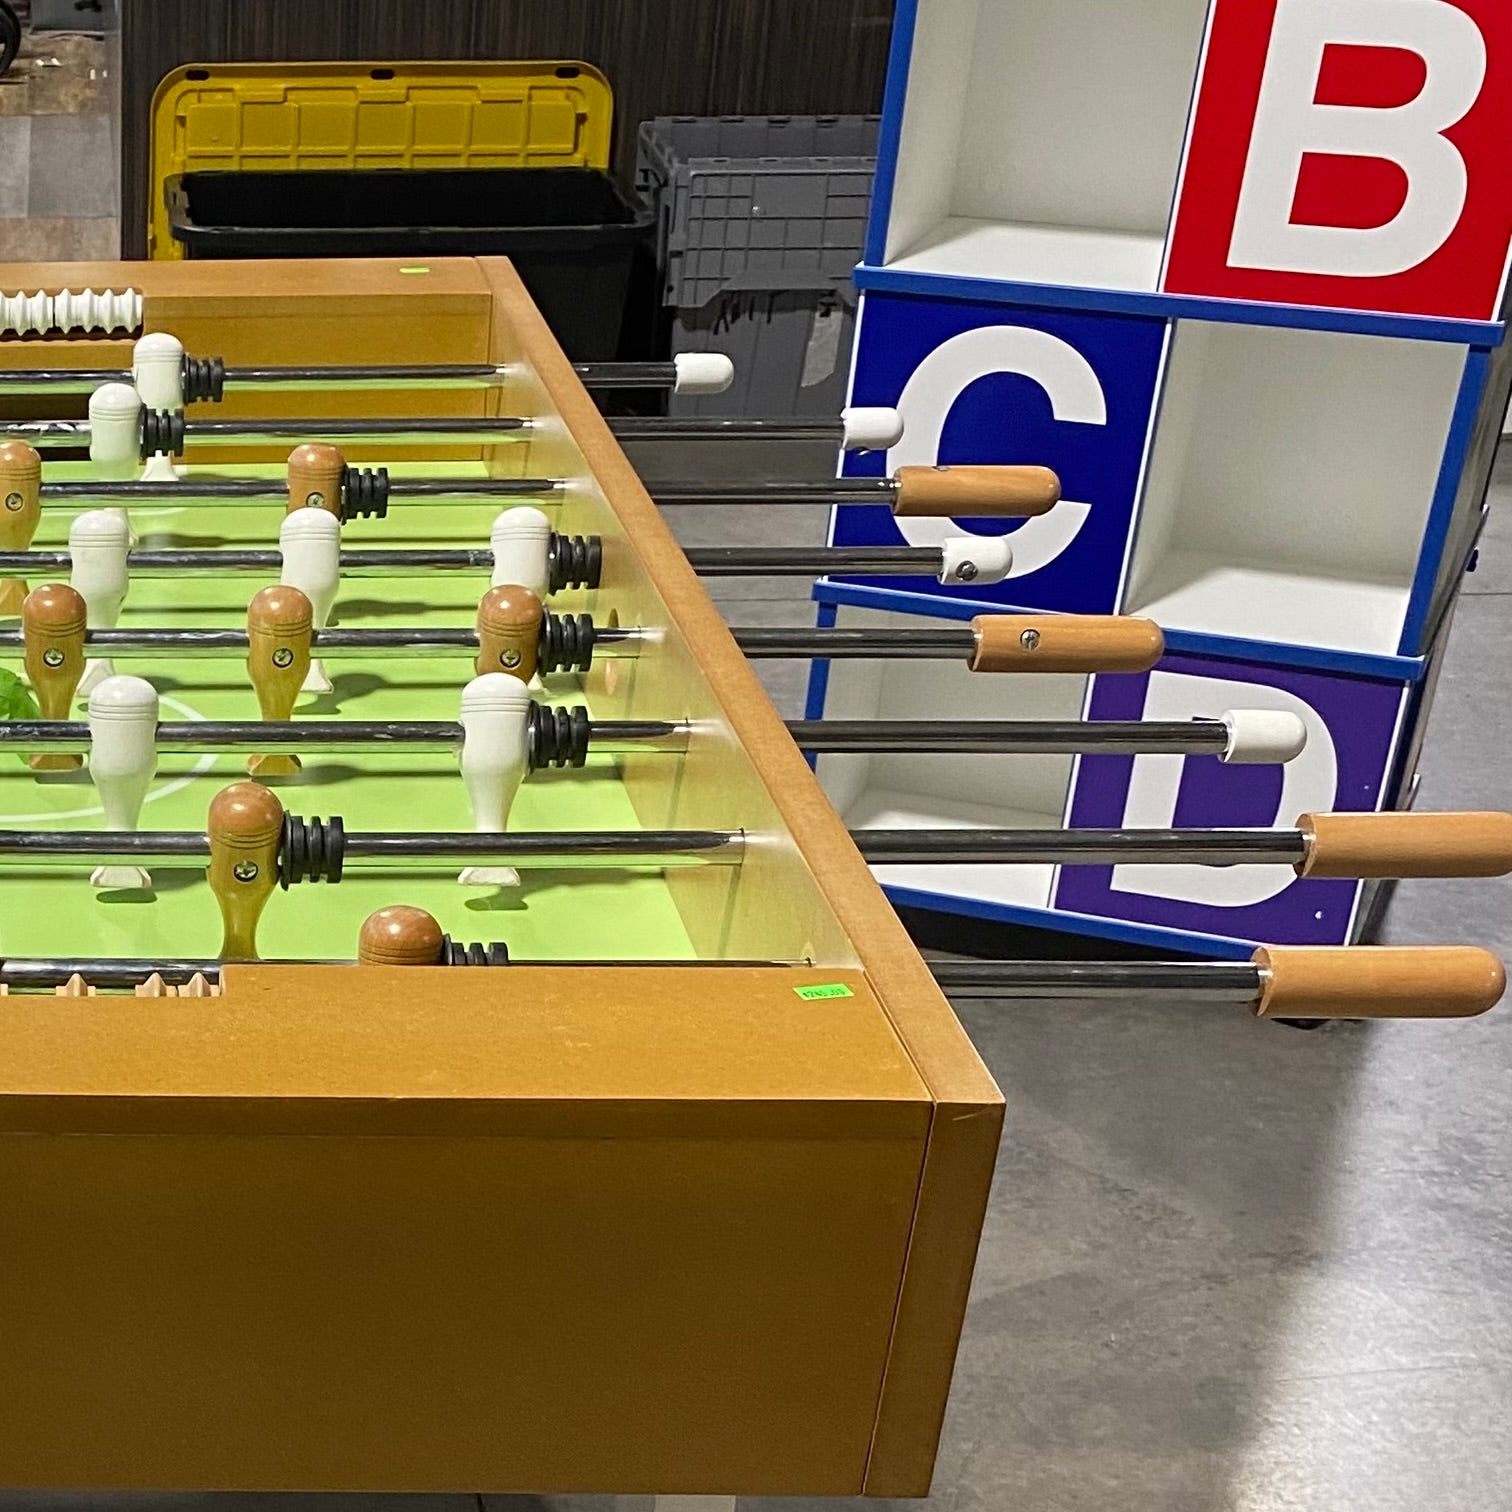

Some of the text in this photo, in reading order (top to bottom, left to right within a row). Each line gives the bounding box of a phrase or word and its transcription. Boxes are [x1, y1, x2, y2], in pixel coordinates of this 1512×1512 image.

[1227, 0, 1487, 278] B
[887, 325, 1107, 580] C
[1109, 671, 1339, 908] D
